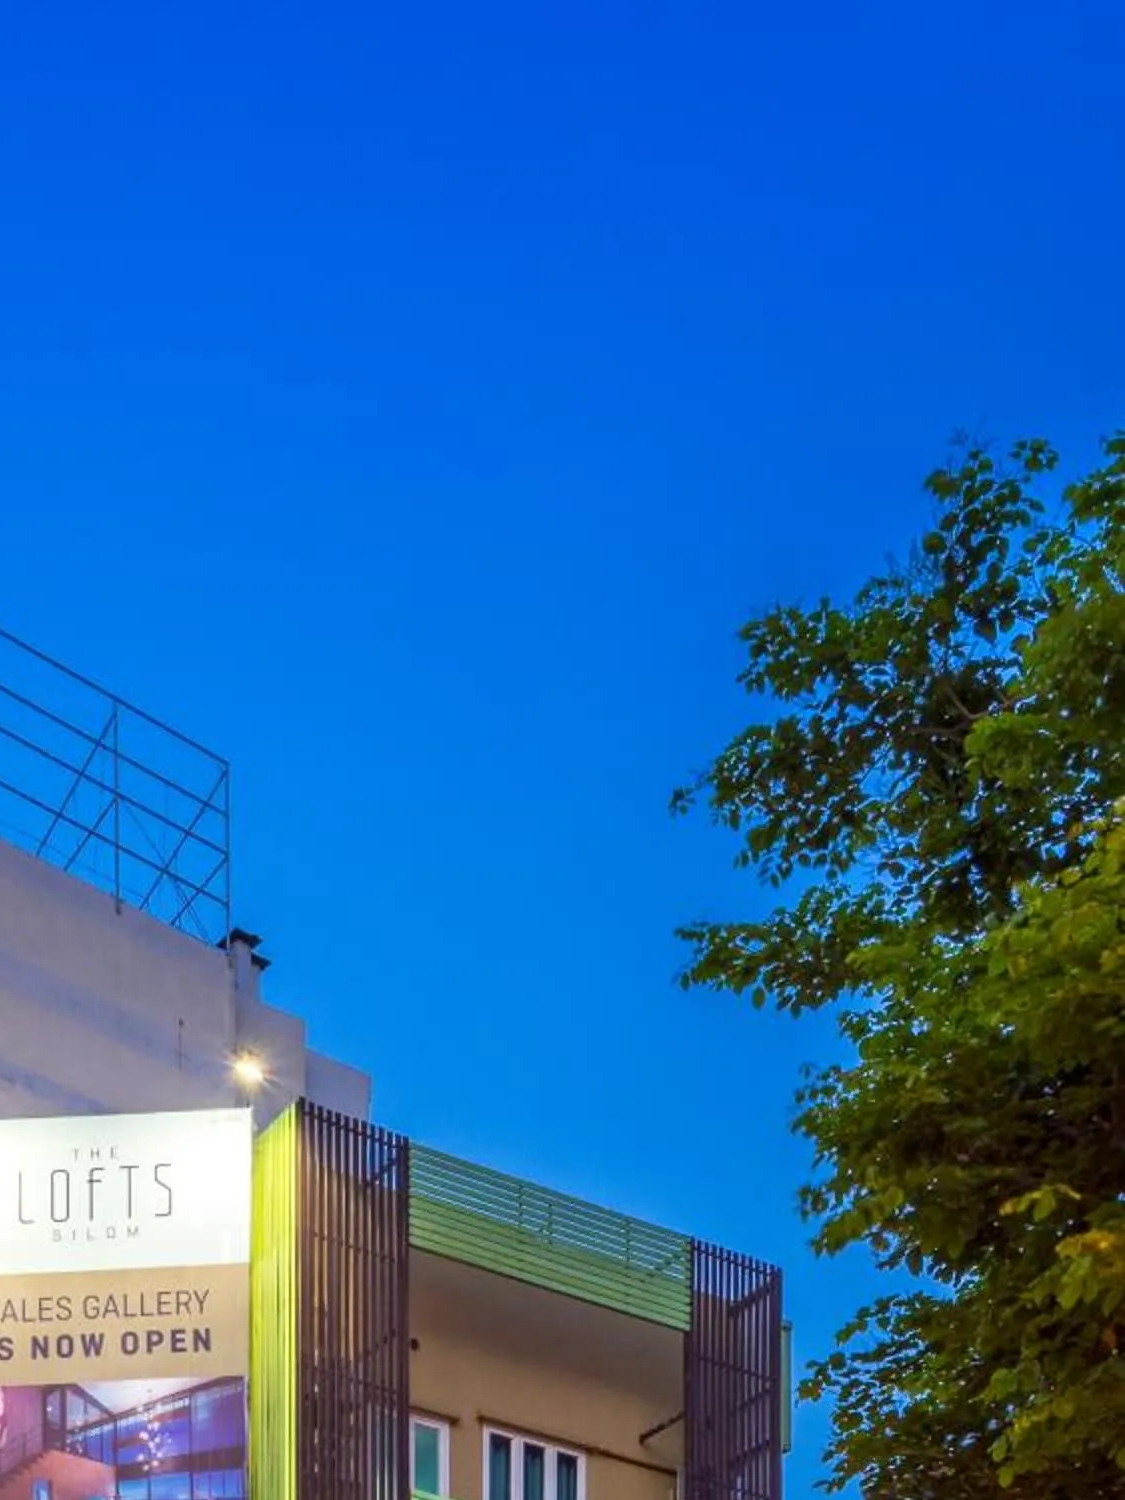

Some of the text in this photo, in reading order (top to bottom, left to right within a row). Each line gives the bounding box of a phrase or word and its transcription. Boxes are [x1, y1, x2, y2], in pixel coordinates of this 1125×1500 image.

[73, 1147, 119, 1161] THE
[18, 1163, 172, 1224] LOFTS
[52, 1226, 141, 1242] SILOM
[83, 1288, 211, 1320] GALLERY
[31, 1333, 105, 1360] NOW
[120, 1327, 213, 1356] OPEN
